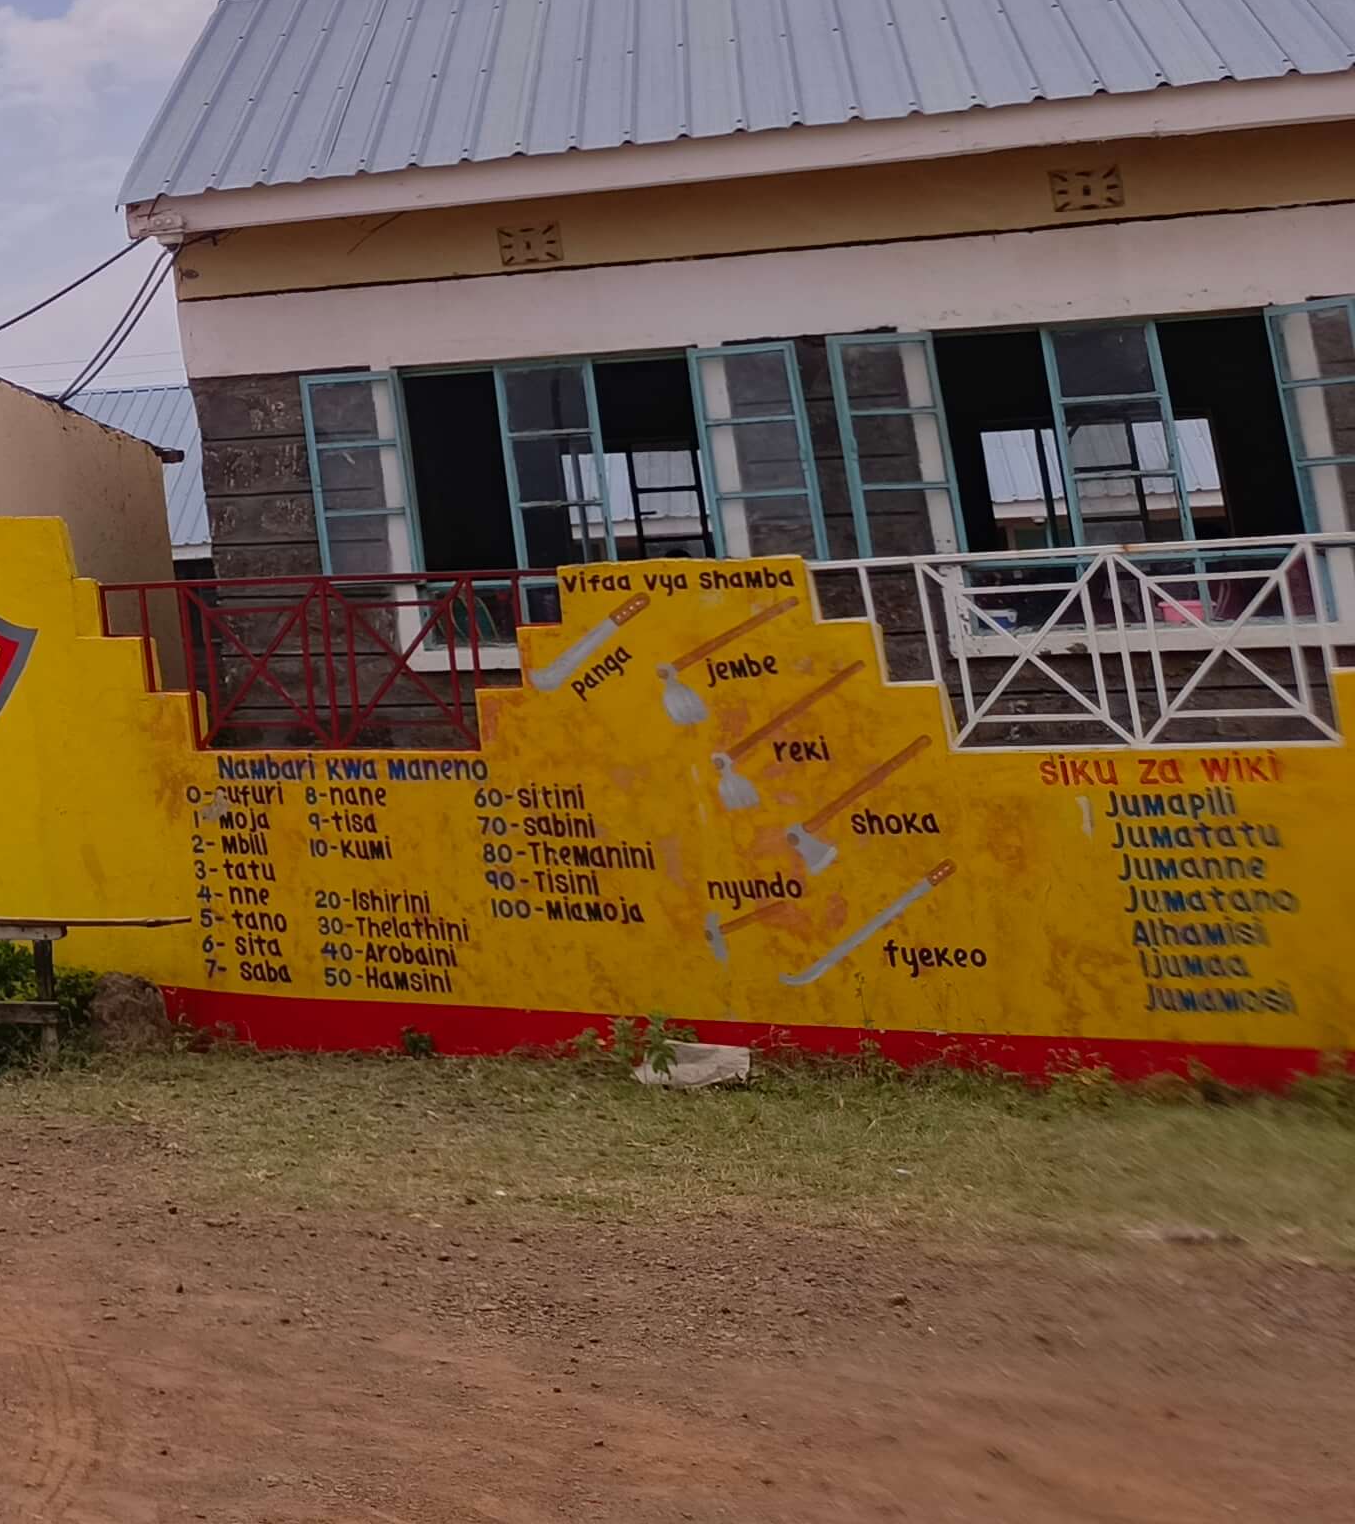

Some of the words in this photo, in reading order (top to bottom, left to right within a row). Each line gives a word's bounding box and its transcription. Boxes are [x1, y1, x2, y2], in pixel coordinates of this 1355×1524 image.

[571, 646, 633, 702] panga
[218, 753, 316, 780] Nambari
[1105, 786, 1236, 820] Jumapili
[1111, 821, 1282, 849] Jumatatu
[1118, 854, 1266, 882] Jumanne
[707, 872, 803, 909] nyundo
[1124, 885, 1299, 914] Jumatano
[1133, 917, 1269, 948] Alhamisi
[1138, 949, 1251, 979] Ijumaa
